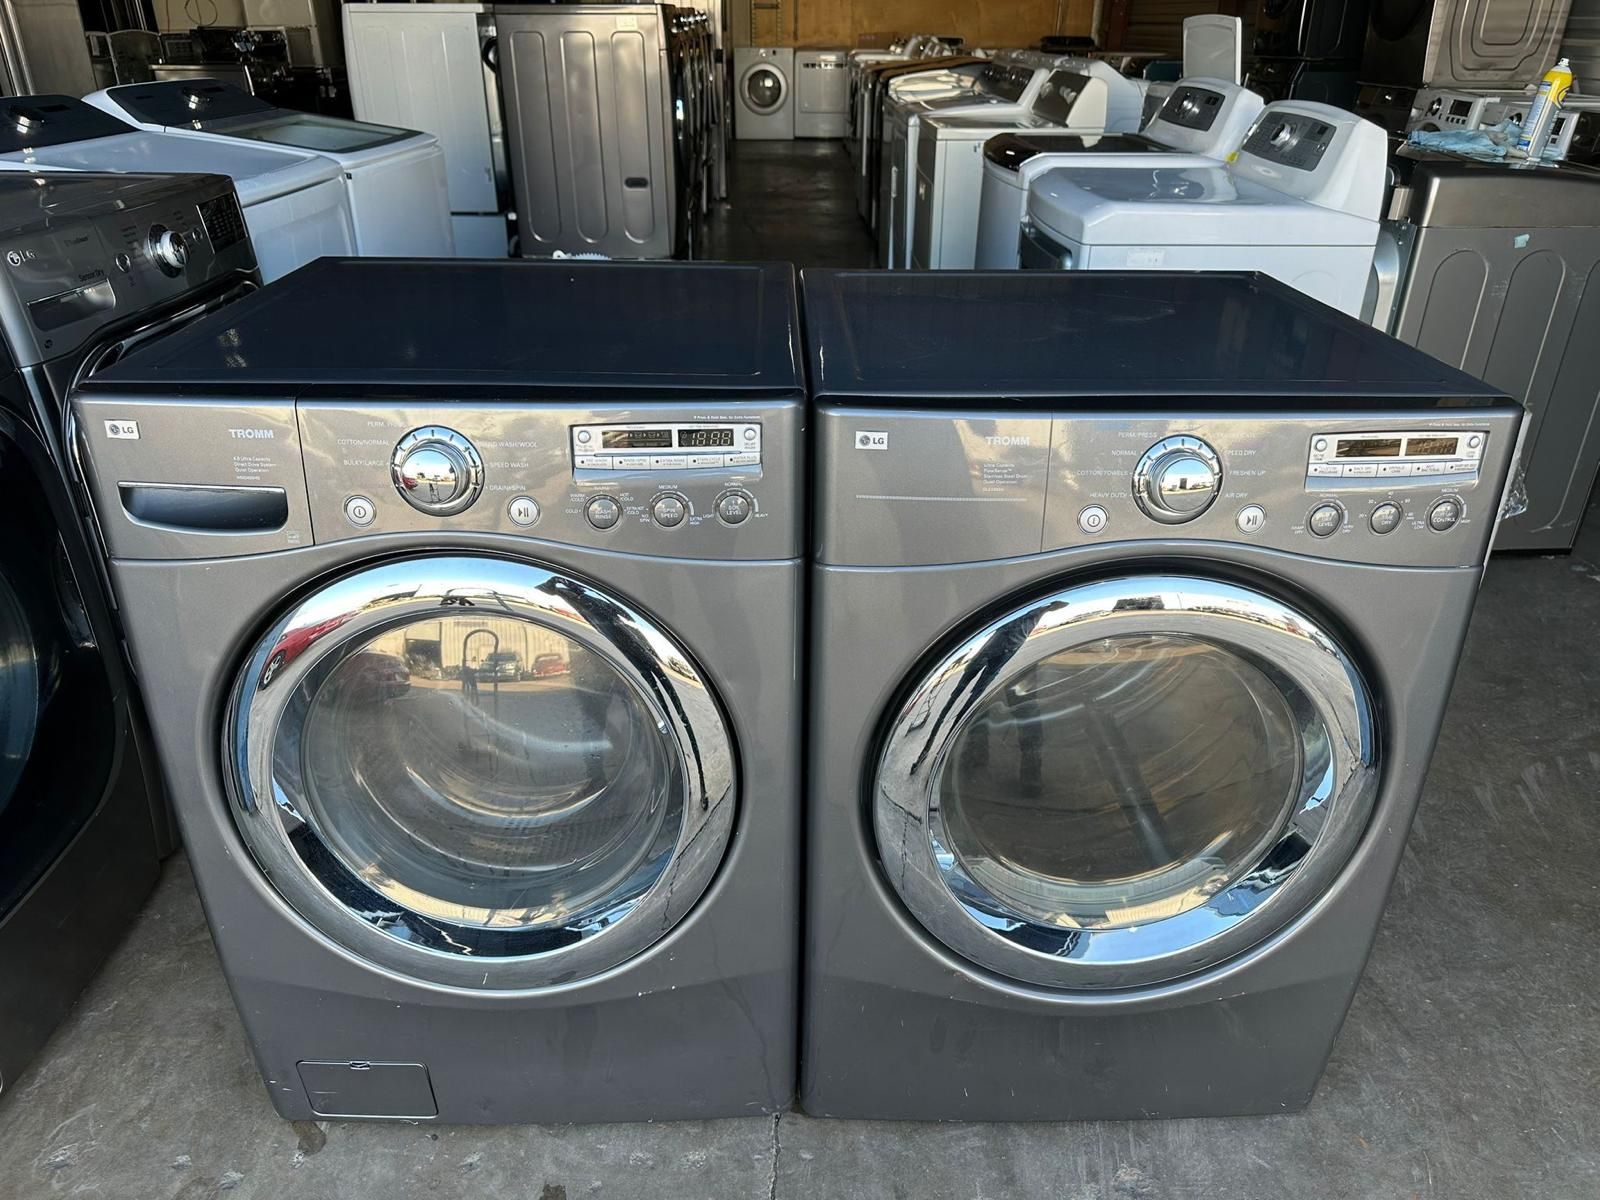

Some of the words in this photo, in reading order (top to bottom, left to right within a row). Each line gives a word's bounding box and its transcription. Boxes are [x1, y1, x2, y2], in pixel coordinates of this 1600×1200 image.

[122, 426, 134, 434] LG
[228, 428, 274, 439] TROMM
[872, 437, 885, 445] LG
[985, 435, 1031, 447] TROMM
[1111, 449, 1137, 457] NORMAL
[1244, 449, 1257, 457] DRY
[510, 460, 529, 468] WASH
[1257, 469, 1267, 477] UP
[1236, 491, 1249, 499] DRY
